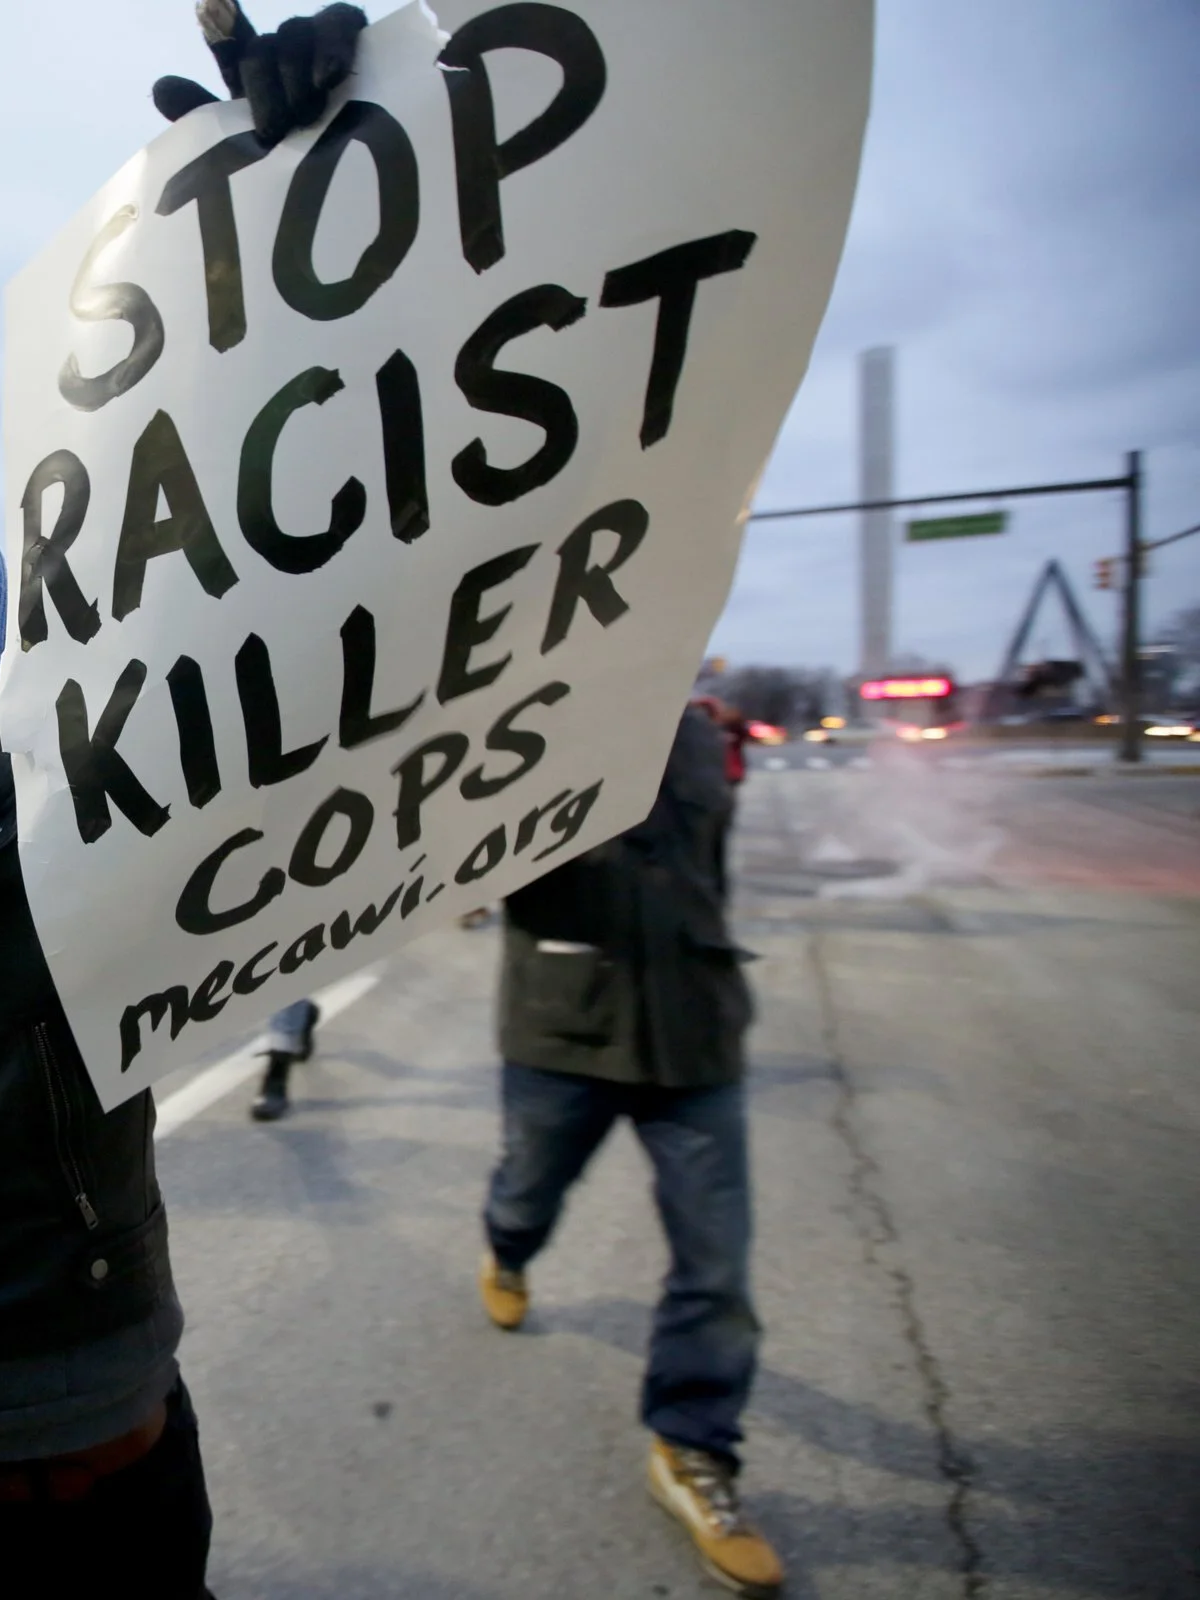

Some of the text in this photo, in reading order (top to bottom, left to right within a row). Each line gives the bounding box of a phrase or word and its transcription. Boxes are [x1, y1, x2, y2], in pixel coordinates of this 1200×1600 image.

[58, 1, 607, 412] STOP
[19, 229, 757, 652] RACIST
[56, 499, 649, 844] KILLER
[175, 681, 571, 935] COPS
[119, 778, 604, 1073] mecawi.org
